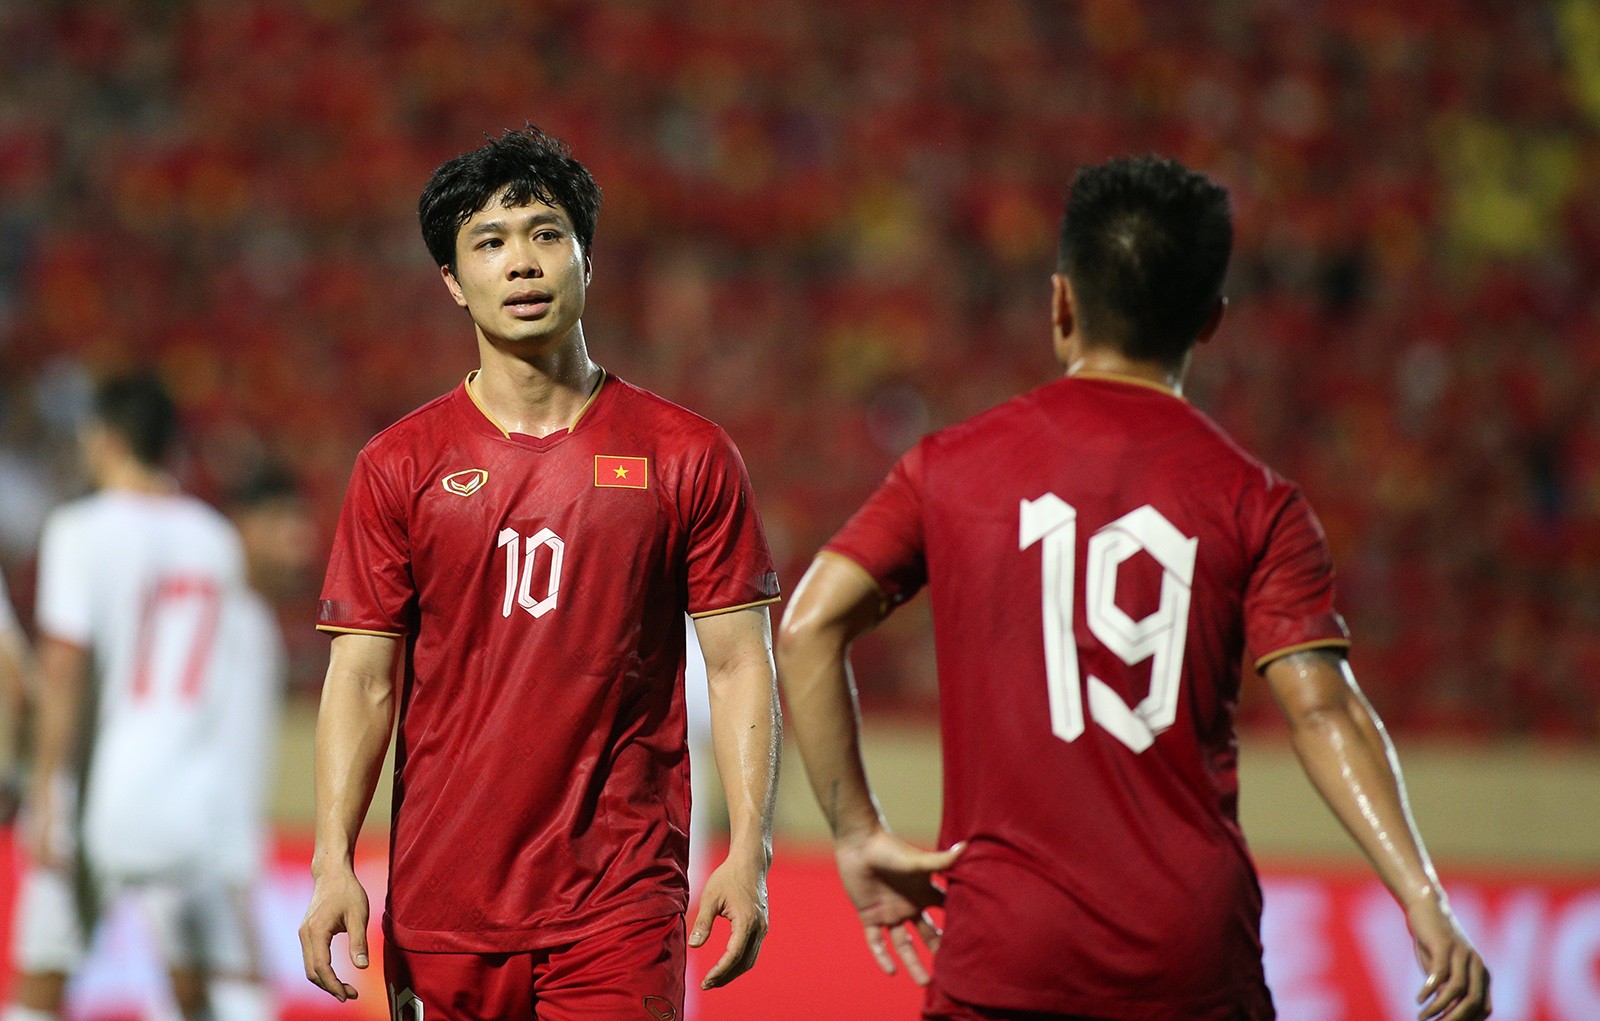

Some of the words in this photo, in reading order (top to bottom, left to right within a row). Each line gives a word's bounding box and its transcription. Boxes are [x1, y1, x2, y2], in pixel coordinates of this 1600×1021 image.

[497, 527, 565, 619] 10
[1019, 491, 1199, 755] 19
[131, 575, 222, 703] 17
